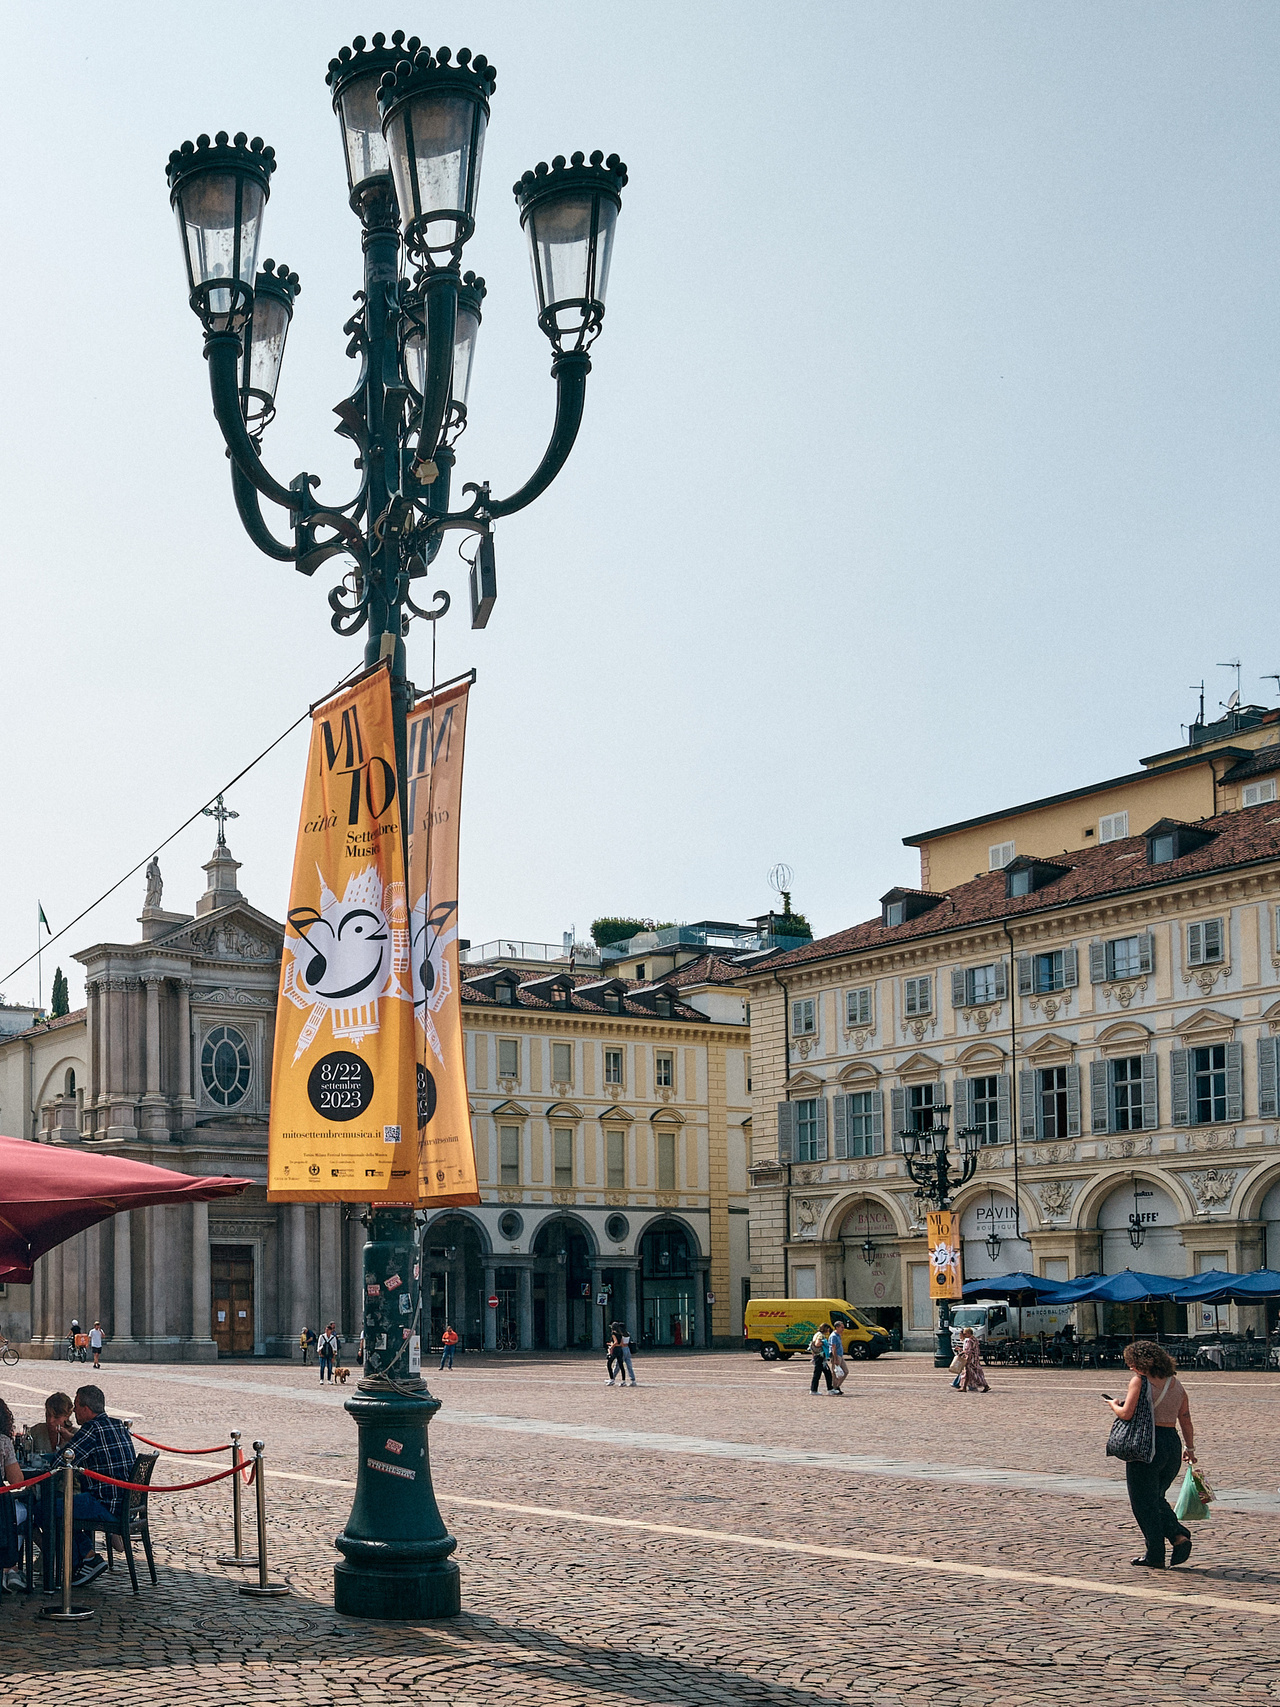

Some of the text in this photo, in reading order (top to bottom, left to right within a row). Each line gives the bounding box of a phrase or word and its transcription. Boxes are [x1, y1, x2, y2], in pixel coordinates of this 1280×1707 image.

[346, 823, 398, 843] Settebre
[321, 1063, 361, 1081] 8/22
[321, 1080, 361, 1090] settembre
[320, 1091, 362, 1108] 2023
[282, 1129, 381, 1139] mitosettembremusica.it
[858, 1213, 888, 1224] BANCA
[1129, 1212, 1159, 1223] CAFFE'
